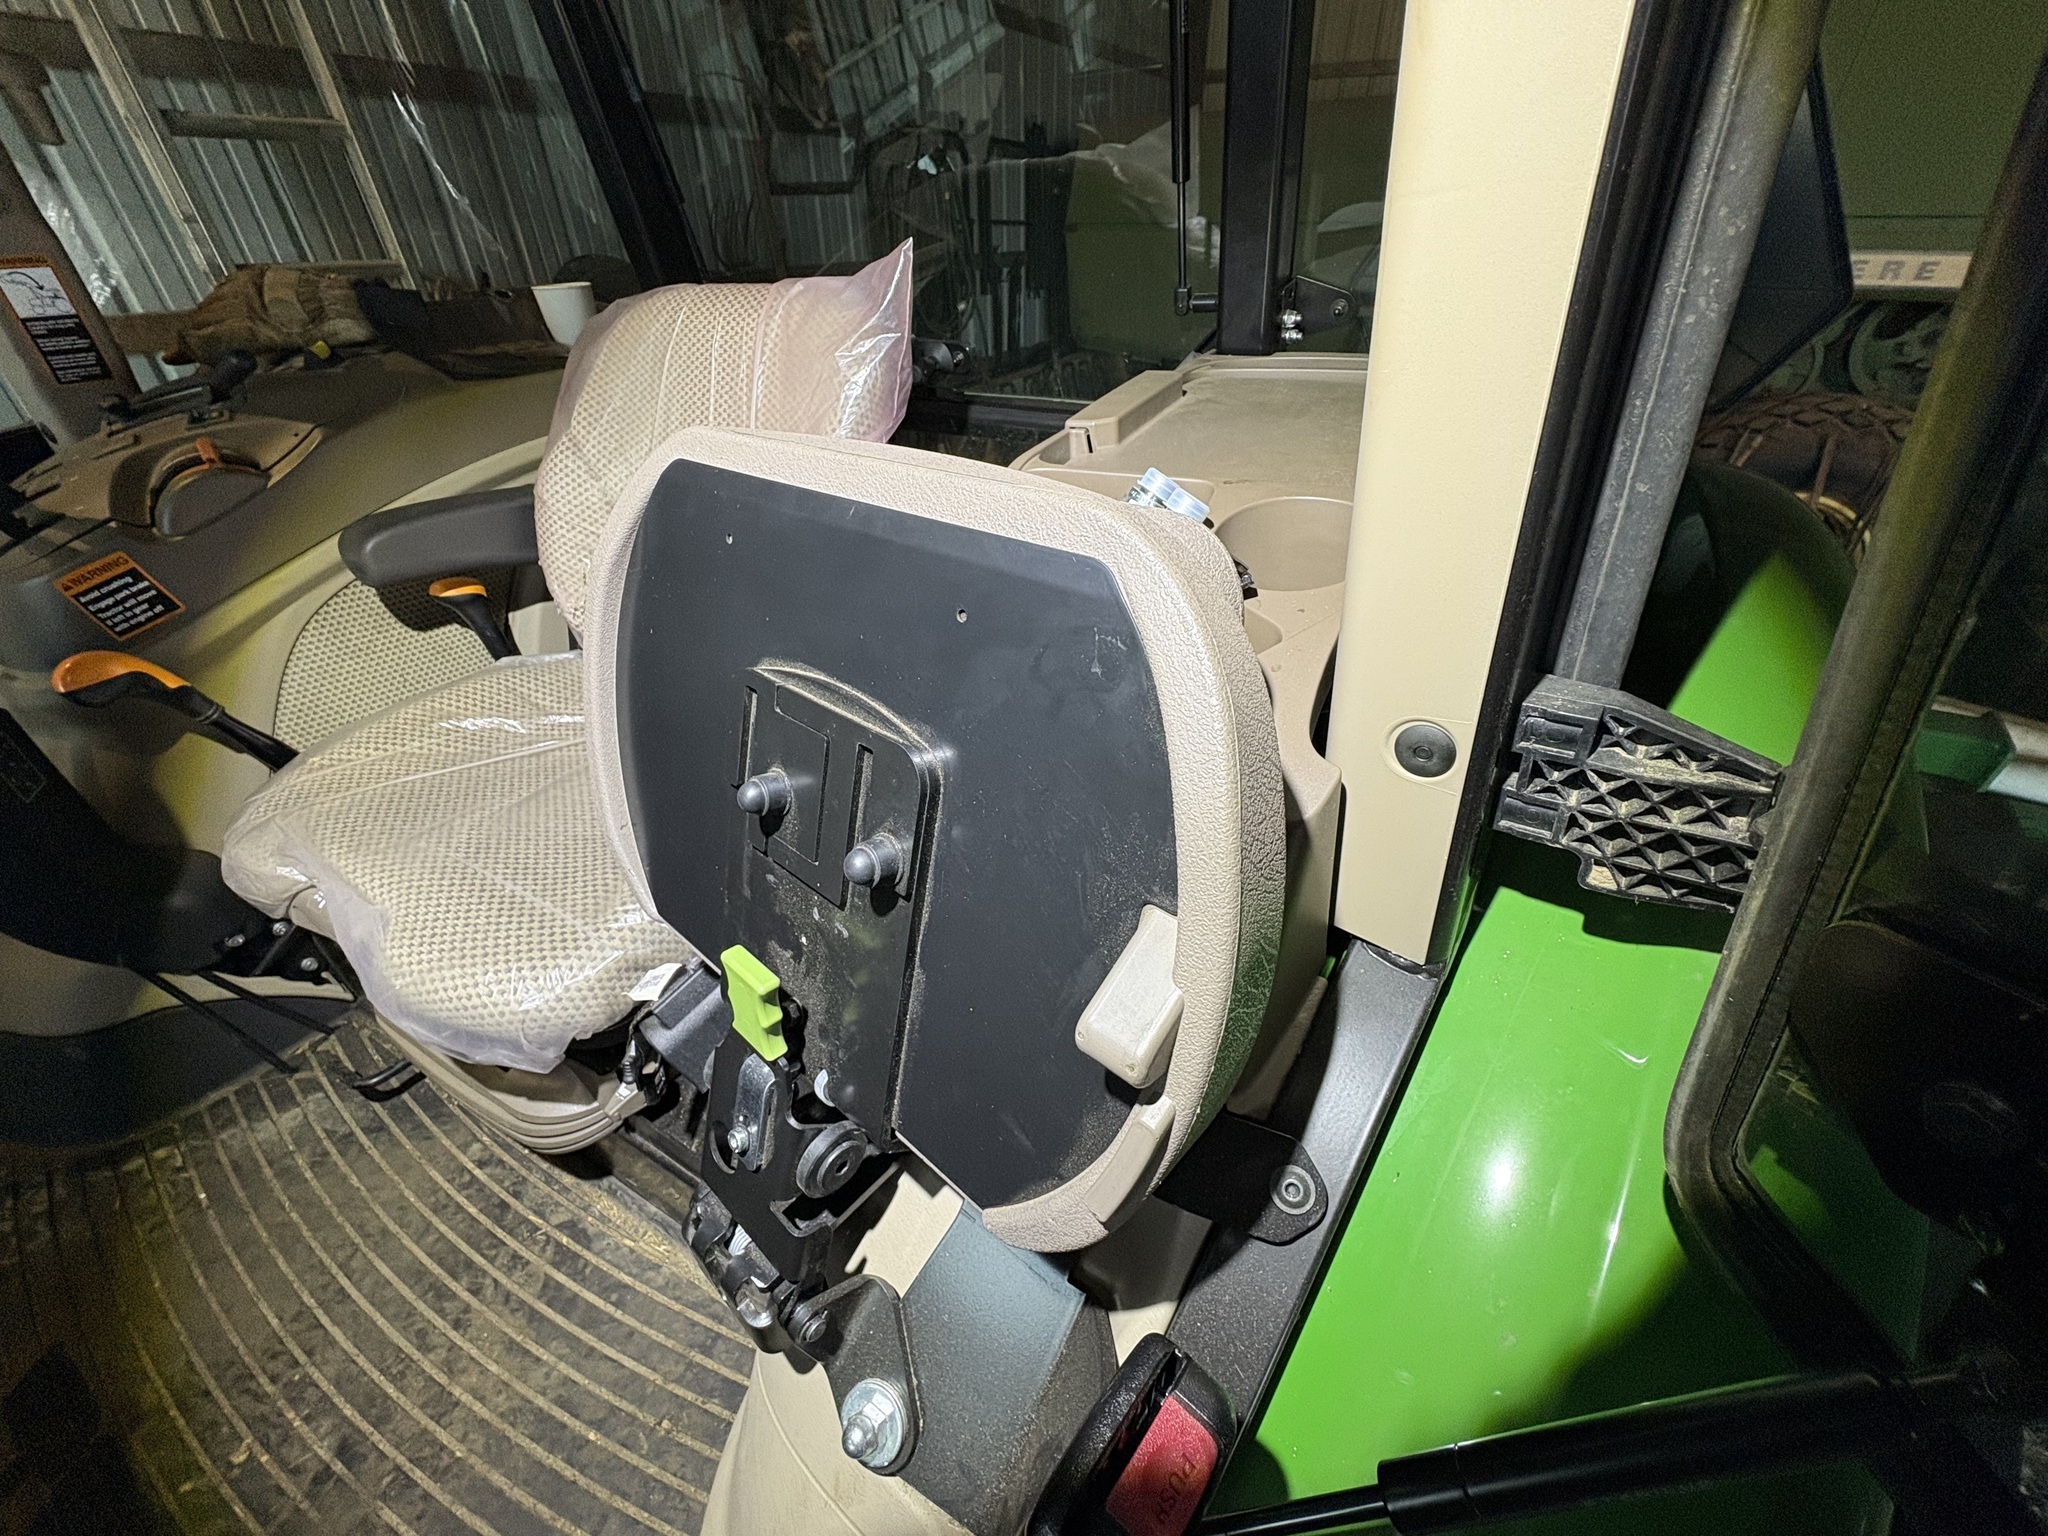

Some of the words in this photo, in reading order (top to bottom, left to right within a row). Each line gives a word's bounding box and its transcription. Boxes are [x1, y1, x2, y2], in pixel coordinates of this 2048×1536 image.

[68, 556, 129, 587] WARNING
[79, 589, 101, 603] Avoid
[100, 576, 133, 594] crushing
[88, 597, 116, 612] Engage
[114, 589, 132, 601] park
[97, 605, 124, 619] Tractor
[123, 598, 138, 608] will
[136, 589, 157, 602] move
[114, 622, 130, 631] with
[129, 610, 154, 625] engine
[152, 604, 165, 614] off
[132, 602, 149, 615] gear
[1153, 1451, 1197, 1526] PUSH
